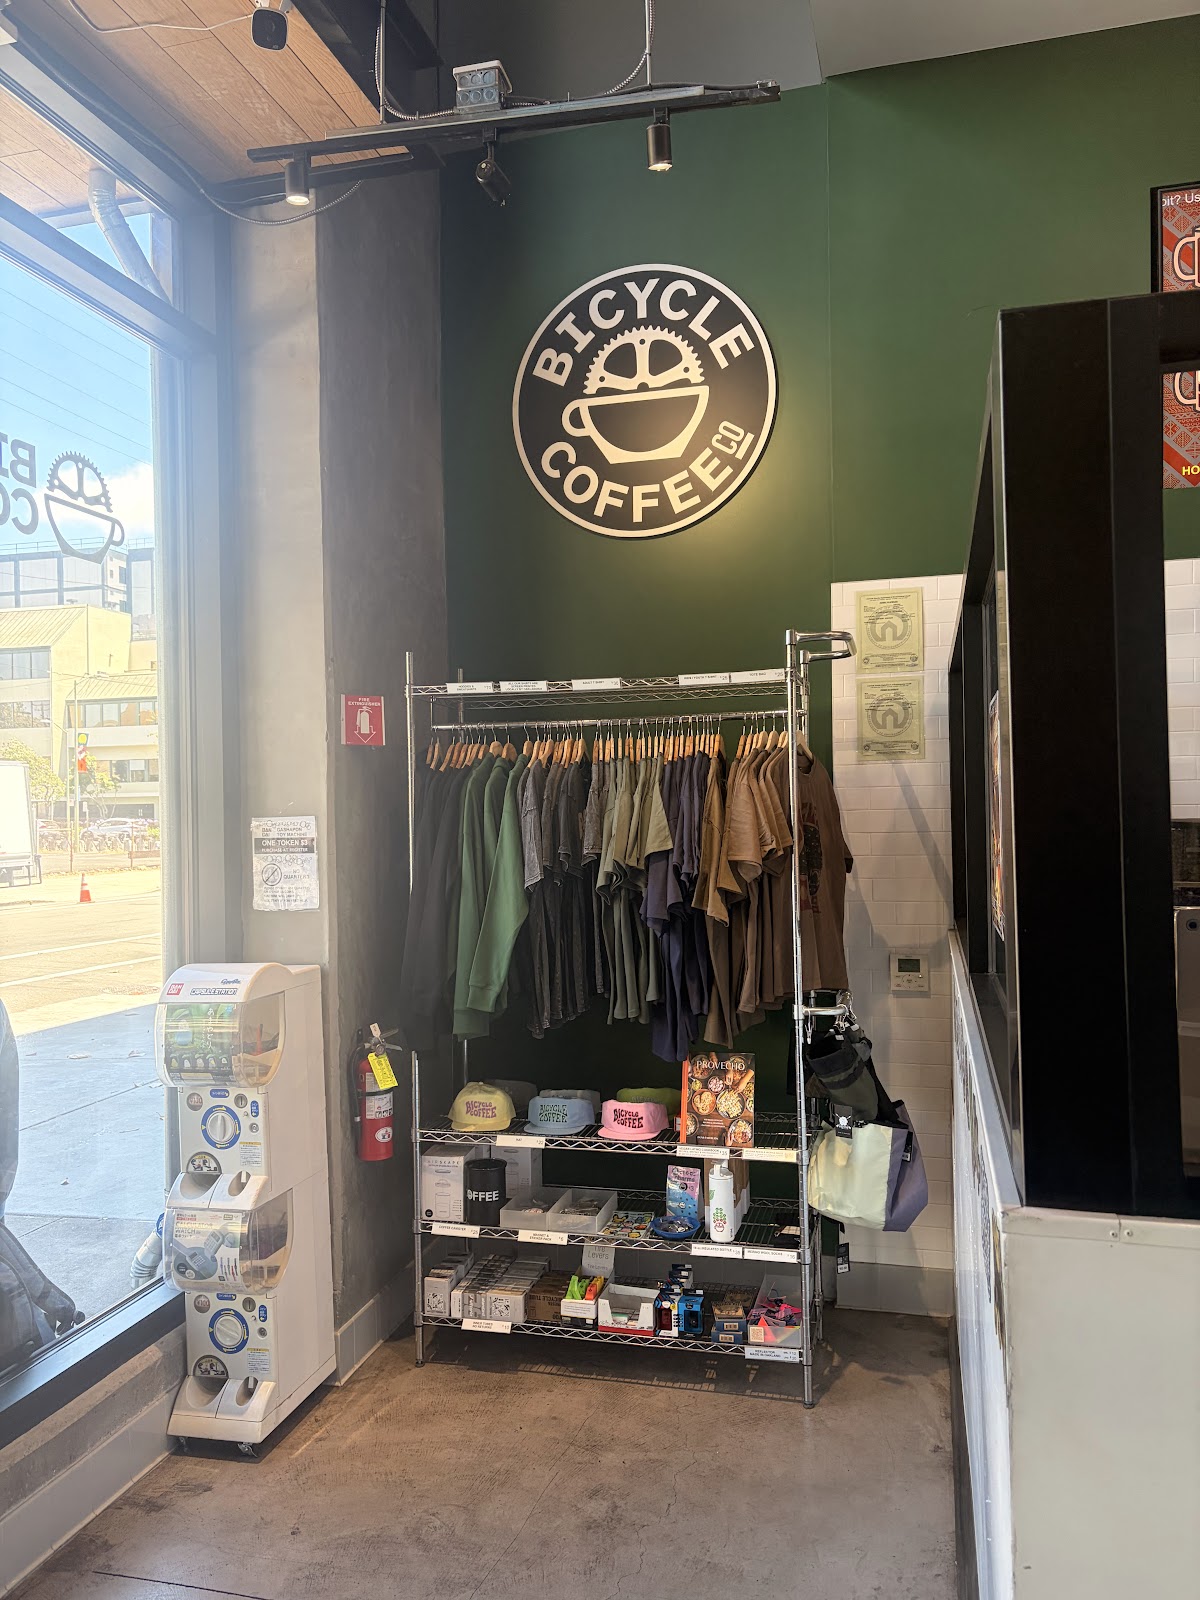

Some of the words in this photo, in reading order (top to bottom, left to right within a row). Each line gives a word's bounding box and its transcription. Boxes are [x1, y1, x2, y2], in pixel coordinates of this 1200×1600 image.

[532, 278, 755, 386] BICYCLE
[541, 440, 733, 523] COFFEE
[696, 1060, 745, 1071] PROVECHO
[465, 1101, 493, 1115] BICYCLE
[470, 1106, 497, 1118] COFFEE
[539, 1104, 568, 1116] BICYCLE
[613, 1108, 639, 1122] BICYCLE
[617, 1116, 643, 1129] COFFEE
[587, 1250, 609, 1259] Levers
